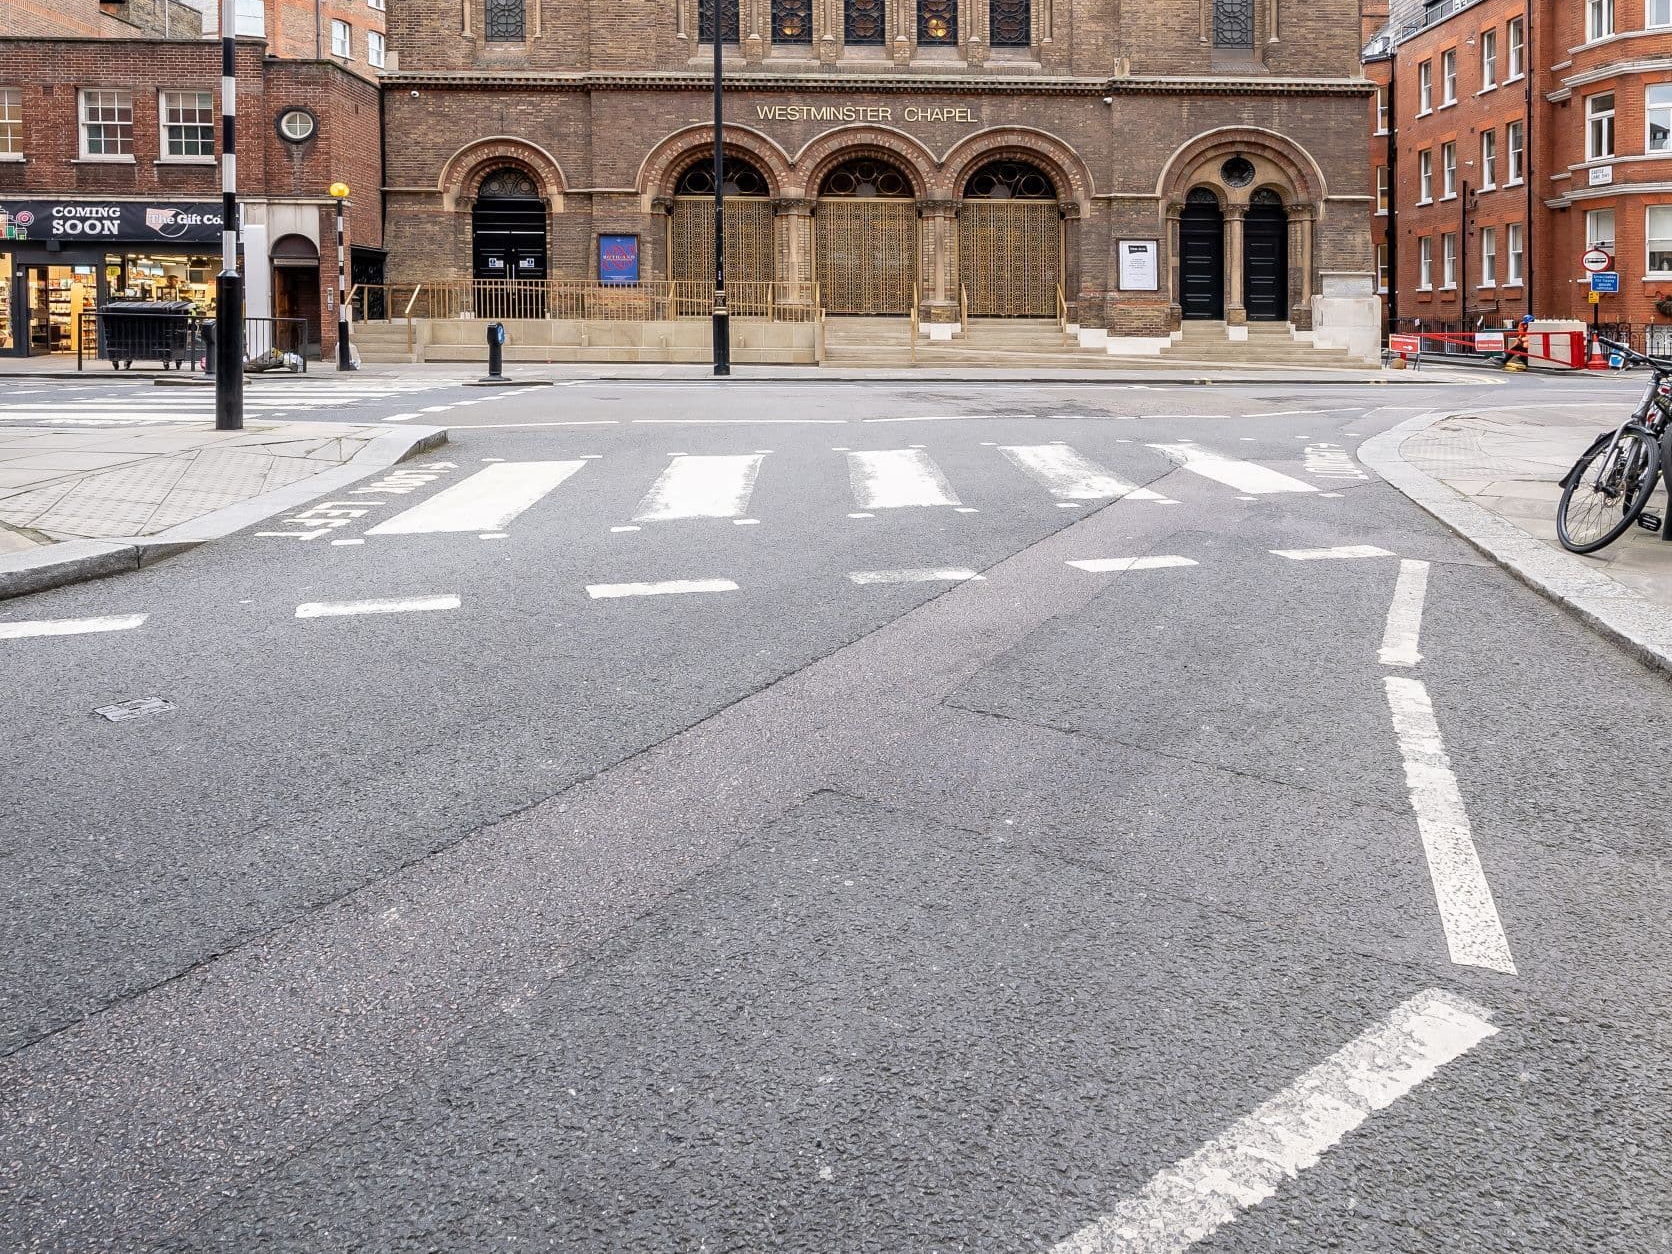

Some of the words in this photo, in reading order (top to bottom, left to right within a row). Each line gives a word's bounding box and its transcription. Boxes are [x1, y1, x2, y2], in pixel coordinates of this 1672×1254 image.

[756, 106, 892, 120] WESTMINSTER
[903, 108, 979, 122] CHAPEL
[52, 207, 121, 218] COMING
[150, 214, 175, 224] The
[177, 214, 202, 225] Gift
[203, 214, 224, 225] Co.
[52, 219, 121, 235] SOON
